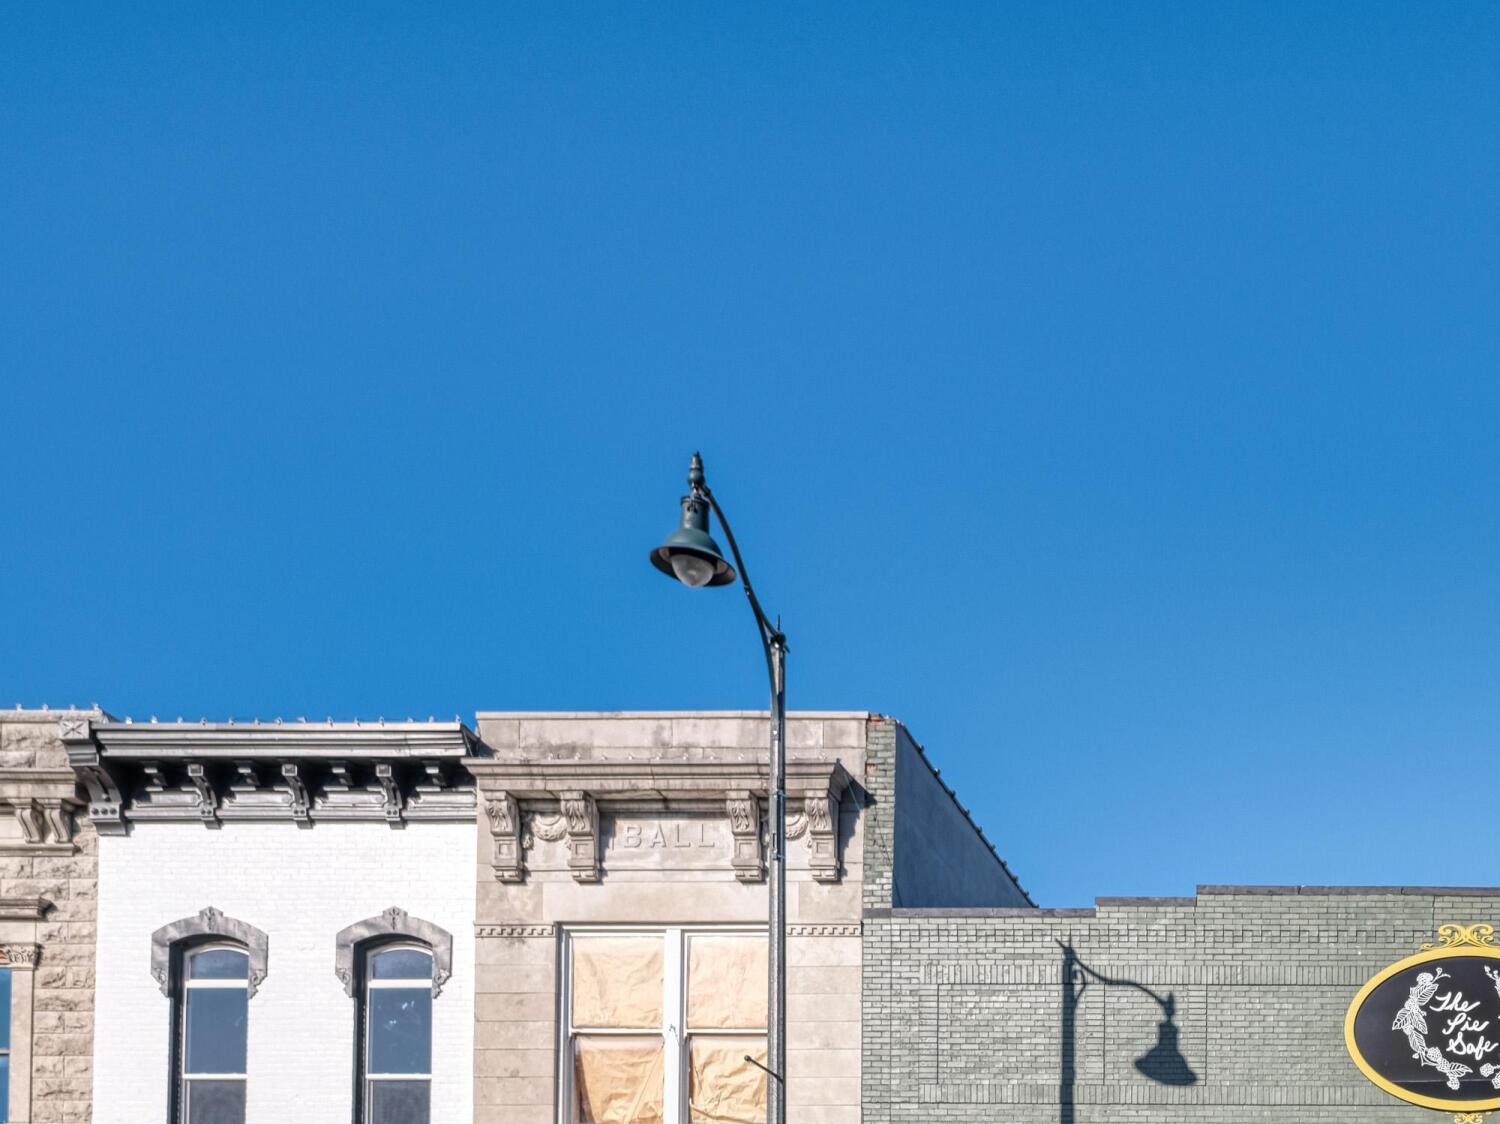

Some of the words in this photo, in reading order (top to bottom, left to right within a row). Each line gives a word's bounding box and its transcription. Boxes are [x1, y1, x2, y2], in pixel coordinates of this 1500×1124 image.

[623, 823, 716, 848] BALL
[1429, 991, 1481, 1012] The
[1441, 1012, 1490, 1035] Pie
[1445, 1031, 1499, 1060] Safe
